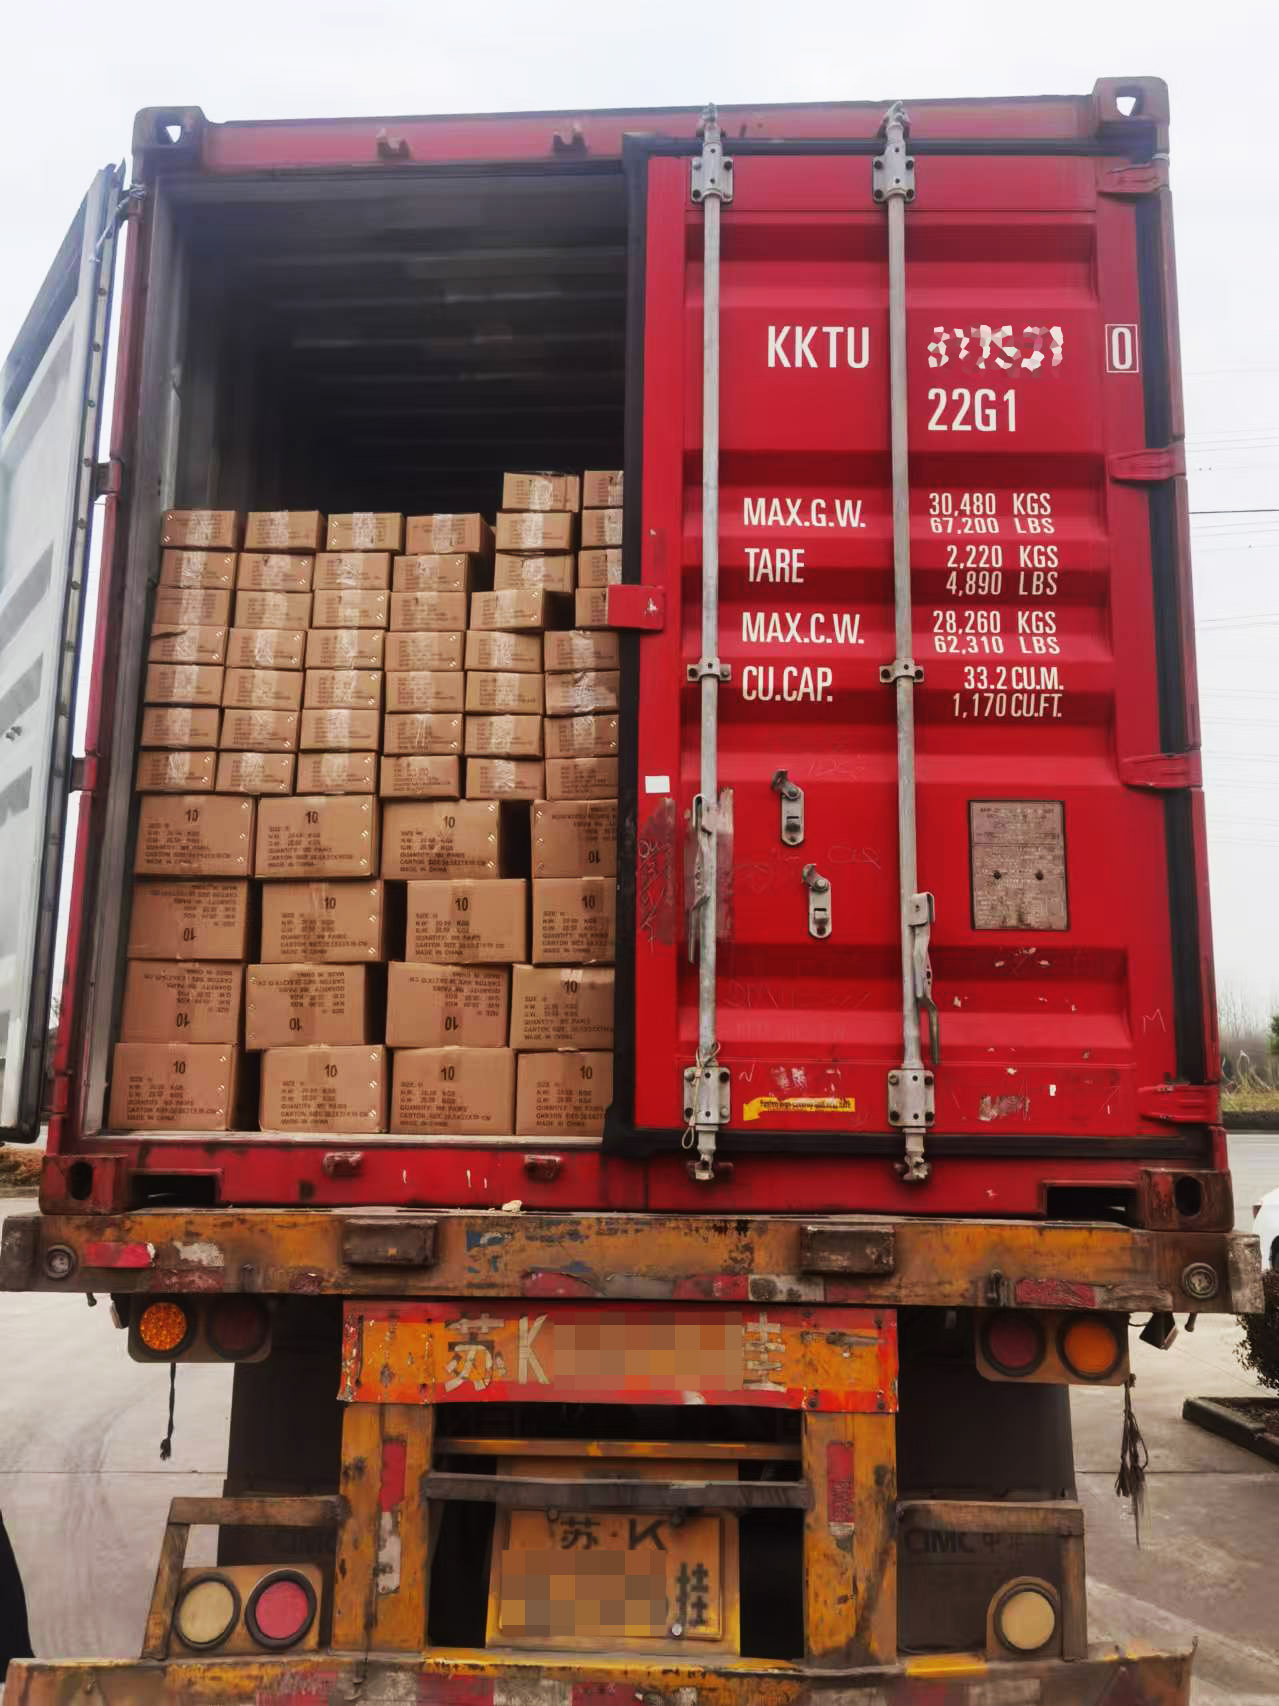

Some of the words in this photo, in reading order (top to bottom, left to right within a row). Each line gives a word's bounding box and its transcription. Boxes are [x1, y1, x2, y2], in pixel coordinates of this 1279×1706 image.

[768, 326, 870, 369] KKTU
[1111, 329, 1133, 369] 0
[928, 387, 1016, 433] 22G1
[743, 497, 867, 529] MAX.G.W.
[929, 492, 996, 517] 30,480
[1012, 492, 1052, 516] KGS
[930, 517, 1000, 536] 67,200
[1014, 517, 1056, 535] LBS
[744, 547, 805, 584] TARE
[946, 545, 1003, 570] 2,220
[1019, 545, 1059, 569] KGS
[946, 570, 1002, 597] 4,890
[1018, 570, 1058, 597] LBS
[741, 611, 865, 645] MAX.C.W.
[932, 611, 1001, 635] 28,260
[1017, 611, 1057, 634] KGS
[934, 635, 1005, 656] 62,310
[1019, 635, 1061, 655] LBS
[742, 665, 834, 703] CU.CAP.
[963, 666, 1008, 690] 33.2
[1011, 666, 1064, 690] CU.M.
[953, 692, 1008, 719] 1,170
[1010, 692, 1063, 719] CU.FT.
[185, 808, 199, 823] 10
[305, 810, 319, 825] 10
[444, 815, 456, 829] 10
[325, 896, 337, 910] 10
[456, 896, 469, 912] 10
[582, 894, 596, 910] 10
[565, 980, 578, 994] 10
[176, 1012, 191, 1029] 10
[289, 1017, 303, 1032] 10
[445, 1016, 459, 1031] 10
[172, 1059, 186, 1074] 10
[324, 1063, 338, 1078] 10
[441, 1065, 455, 1081] 10
[579, 1065, 593, 1080] 10
[675, 1562, 709, 1627] 挂
